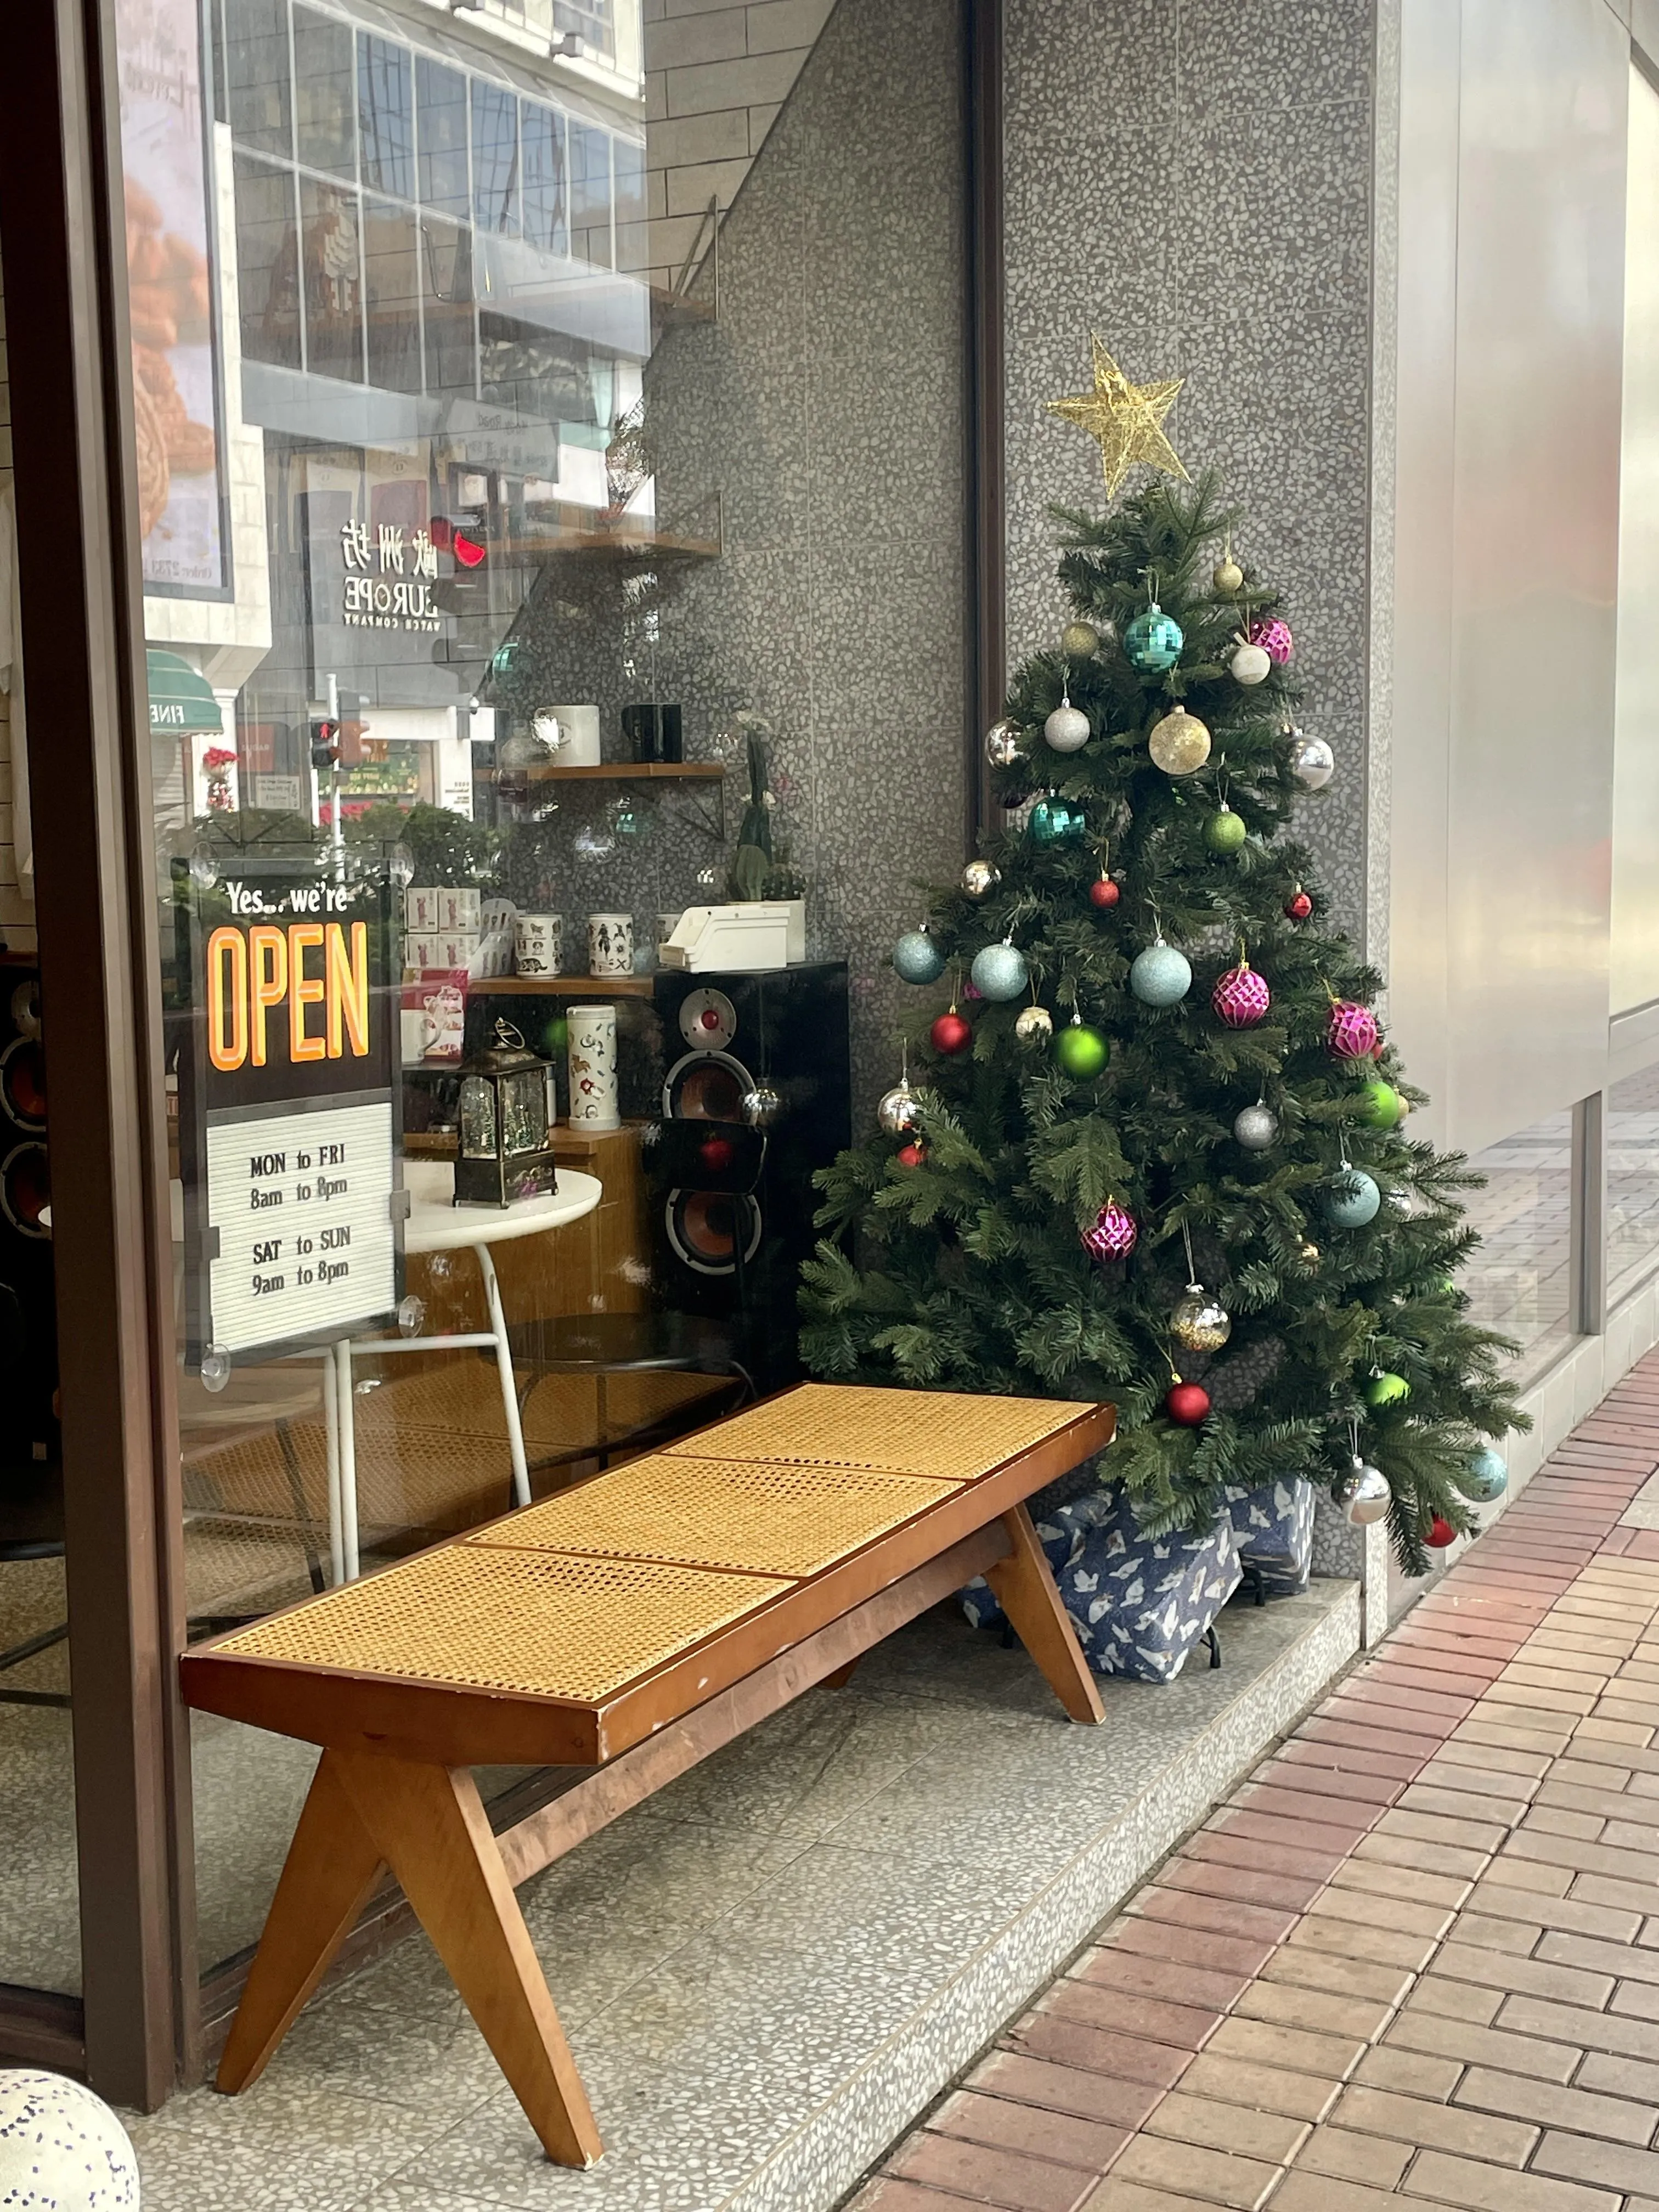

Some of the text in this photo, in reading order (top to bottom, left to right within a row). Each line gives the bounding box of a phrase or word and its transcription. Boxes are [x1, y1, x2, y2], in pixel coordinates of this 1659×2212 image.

[226, 881, 348, 914] Yes... we're
[207, 922, 369, 1071] OPEN
[251, 1144, 345, 1178] MON to FRI
[251, 1177, 348, 1210] 8am to 8pm
[253, 1226, 351, 1265] SAT to SUN
[252, 1260, 348, 1296] 9am to 8pm
